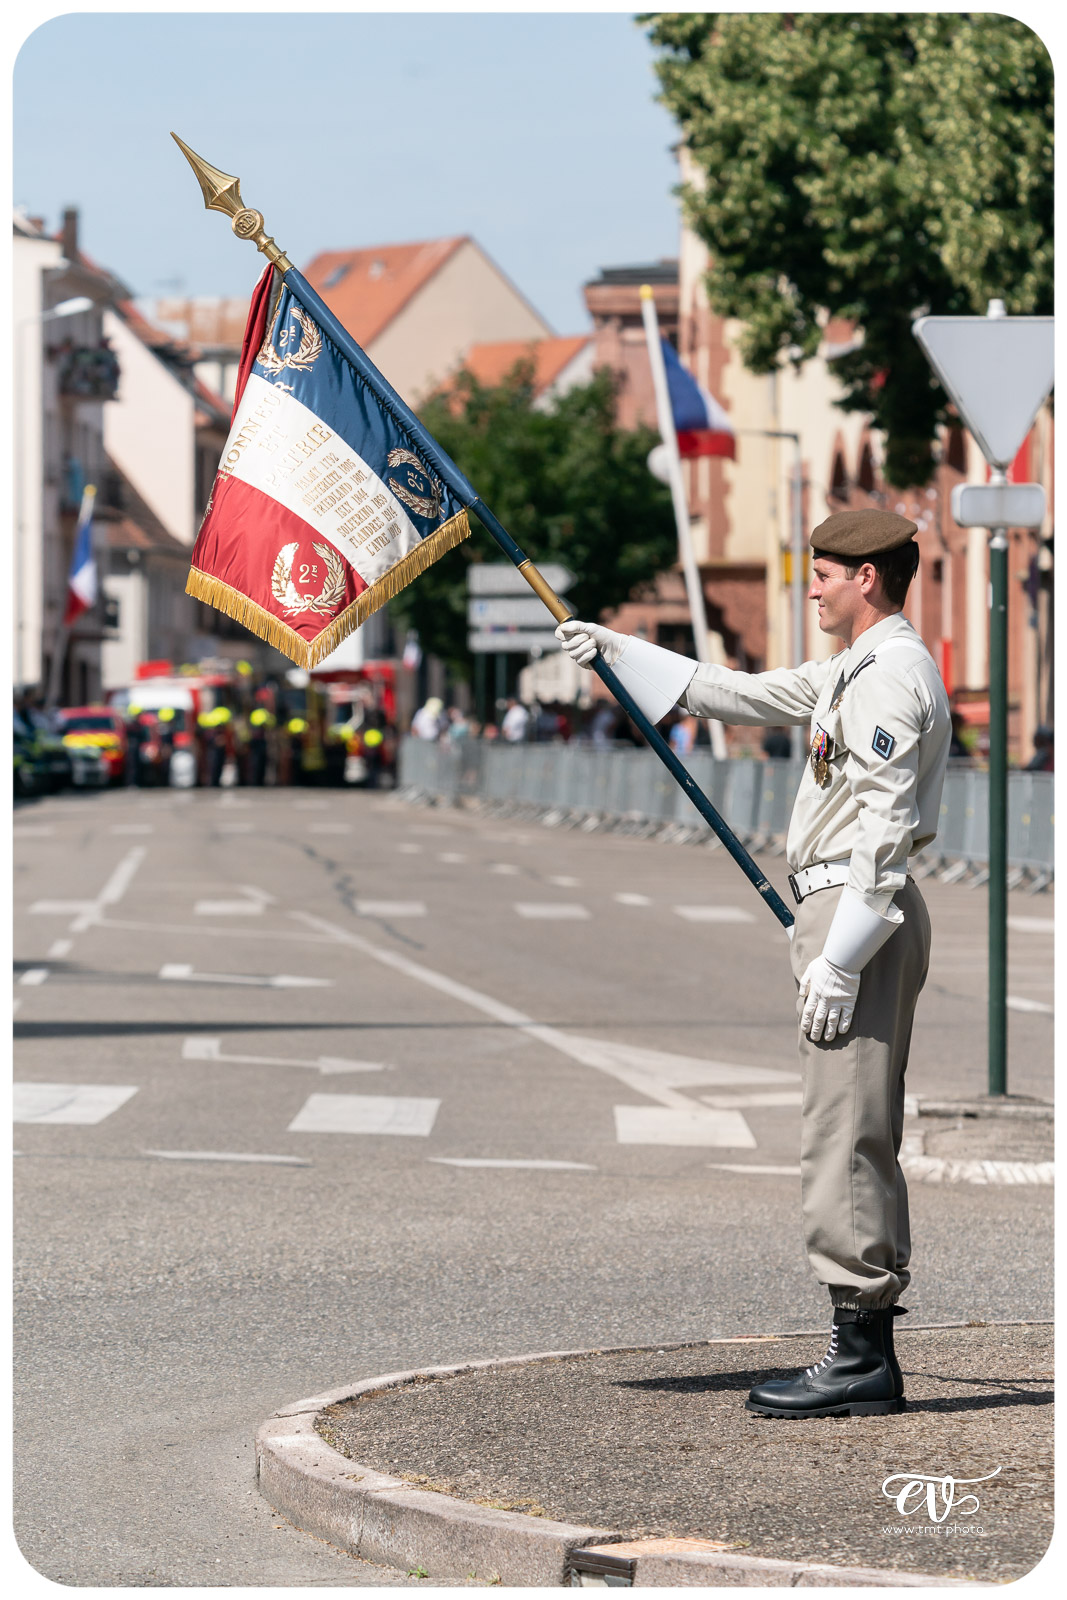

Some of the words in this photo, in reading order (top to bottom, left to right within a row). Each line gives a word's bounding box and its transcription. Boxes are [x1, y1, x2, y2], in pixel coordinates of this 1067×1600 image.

[217, 381, 294, 483] HONNEUR
[266, 423, 332, 488] PATRIE
[294, 466, 322, 491] VALMY
[319, 452, 340, 470] 1792
[337, 458, 357, 474] 1805
[312, 482, 353, 517] FRIEDLAND
[349, 469, 368, 485] 1807
[334, 500, 355, 519] ISLY
[351, 487, 370, 506] 1844
[336, 504, 375, 538] SOLFERINO
[370, 493, 388, 510] 1859
[349, 516, 385, 549] FLANDRES
[381, 505, 399, 522] 1914
[365, 532, 391, 557] L'AVRE
[387, 522, 402, 540] 1918
[879, 738, 886, 746] 2
